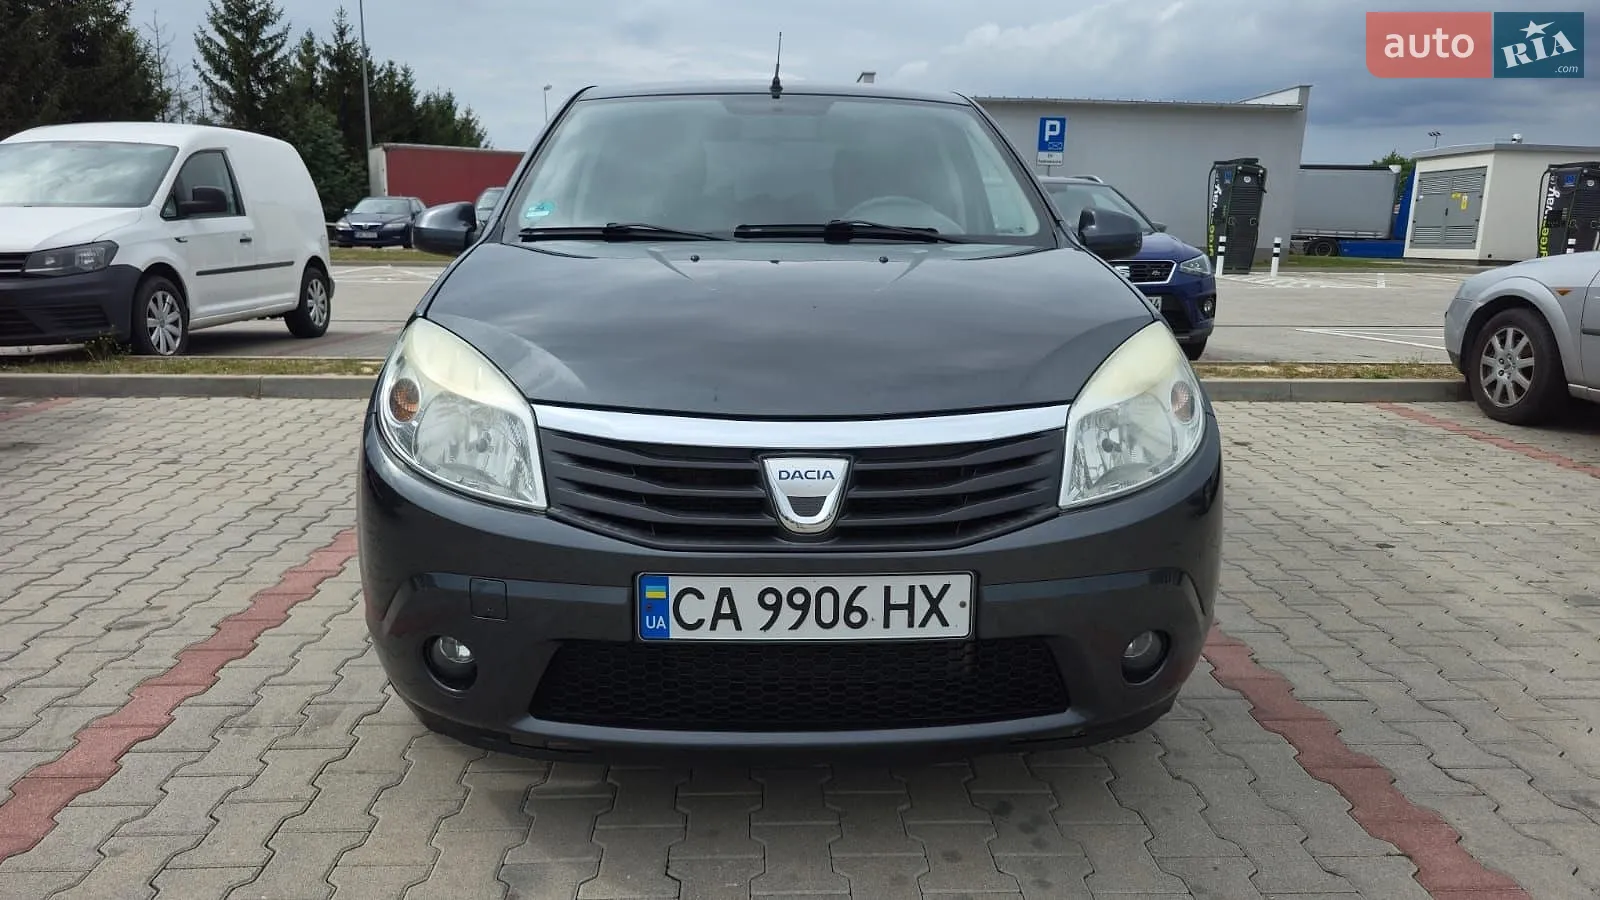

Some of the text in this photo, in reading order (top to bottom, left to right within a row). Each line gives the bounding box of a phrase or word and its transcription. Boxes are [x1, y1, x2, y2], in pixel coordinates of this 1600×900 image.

[1044, 120, 1061, 142] P
[778, 470, 835, 481] DACIA
[672, 583, 952, 631] CA 9906 HX
[646, 615, 667, 630] UA
